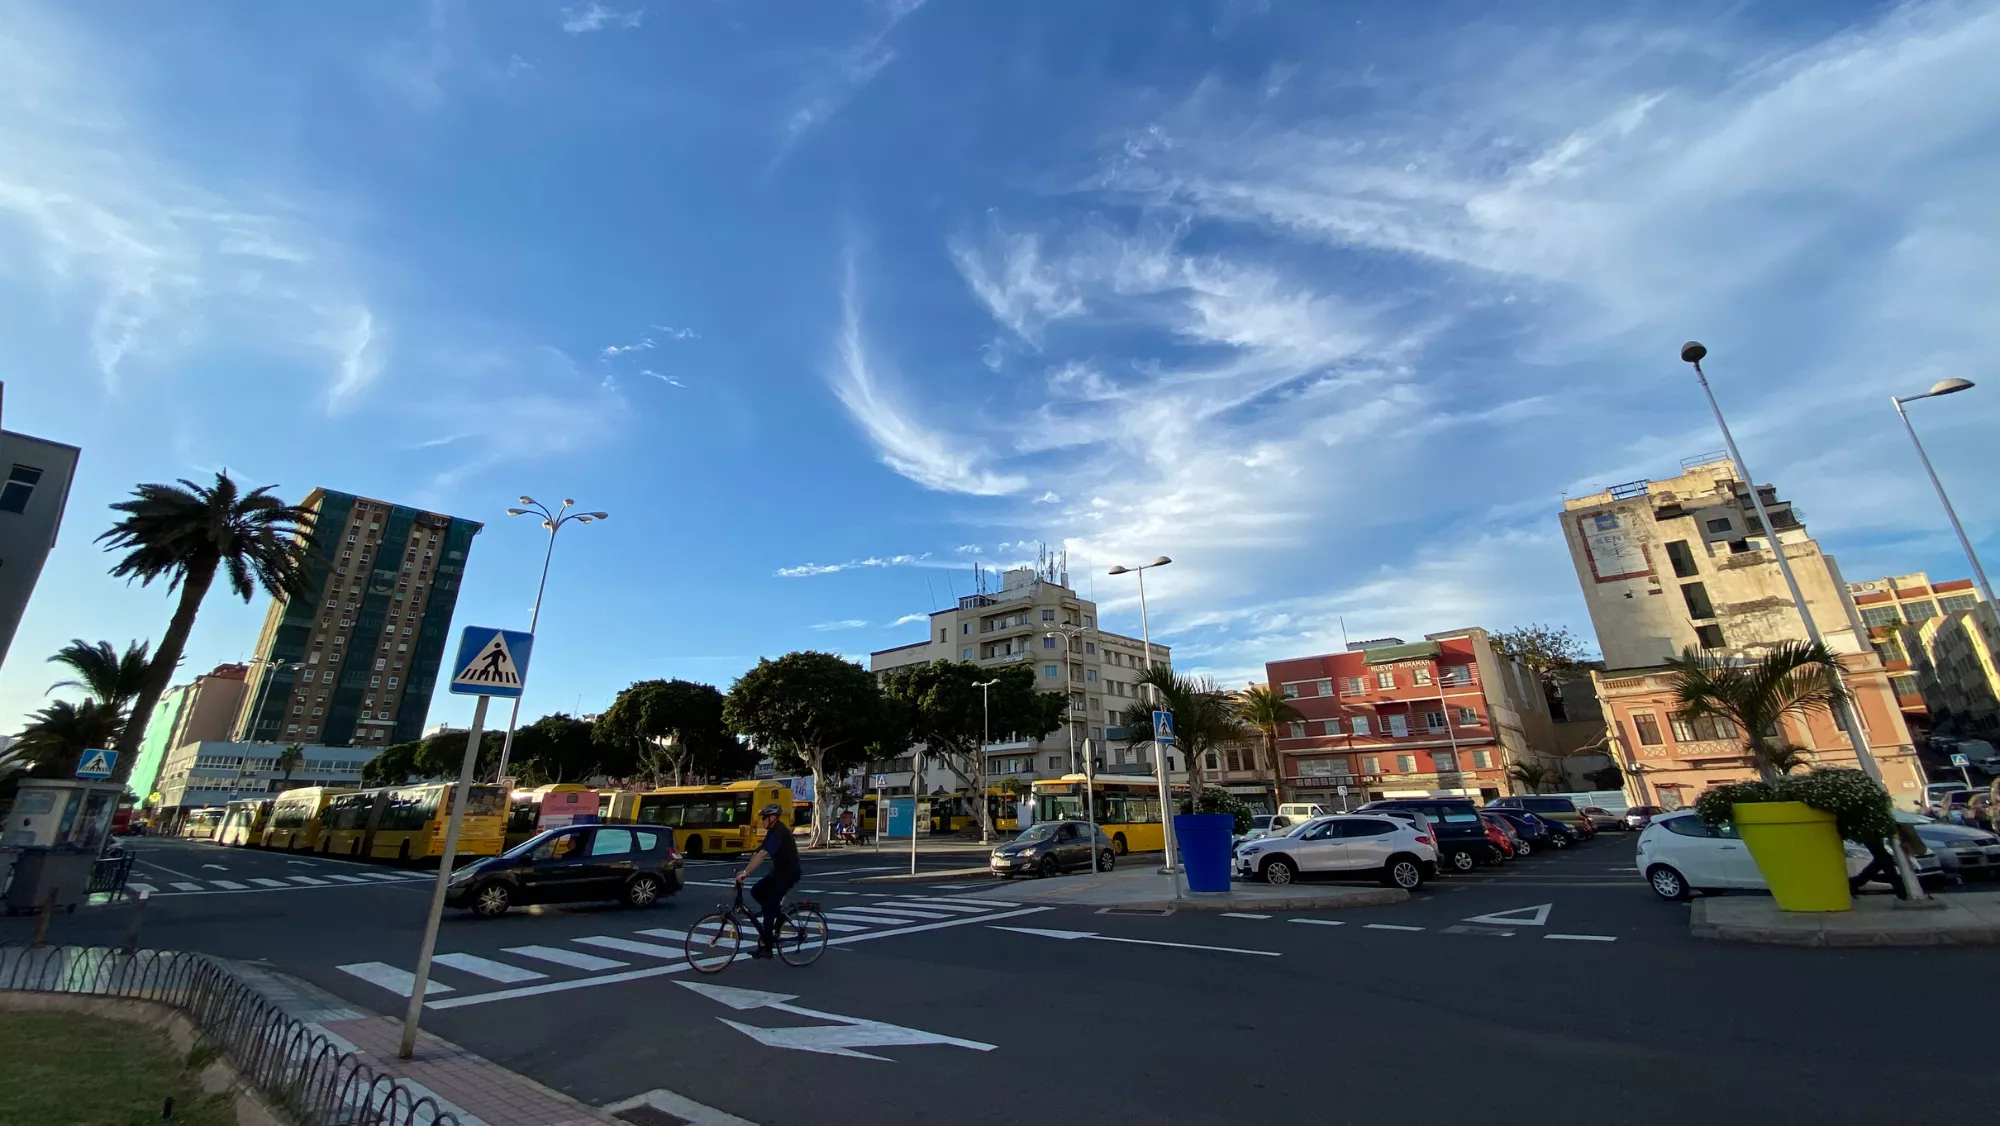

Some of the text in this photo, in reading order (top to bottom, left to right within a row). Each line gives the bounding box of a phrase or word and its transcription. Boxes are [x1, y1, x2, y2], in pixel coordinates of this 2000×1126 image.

[1371, 660, 1430, 672] NUEVO MIRAMAR
[889, 807, 898, 818] 33
